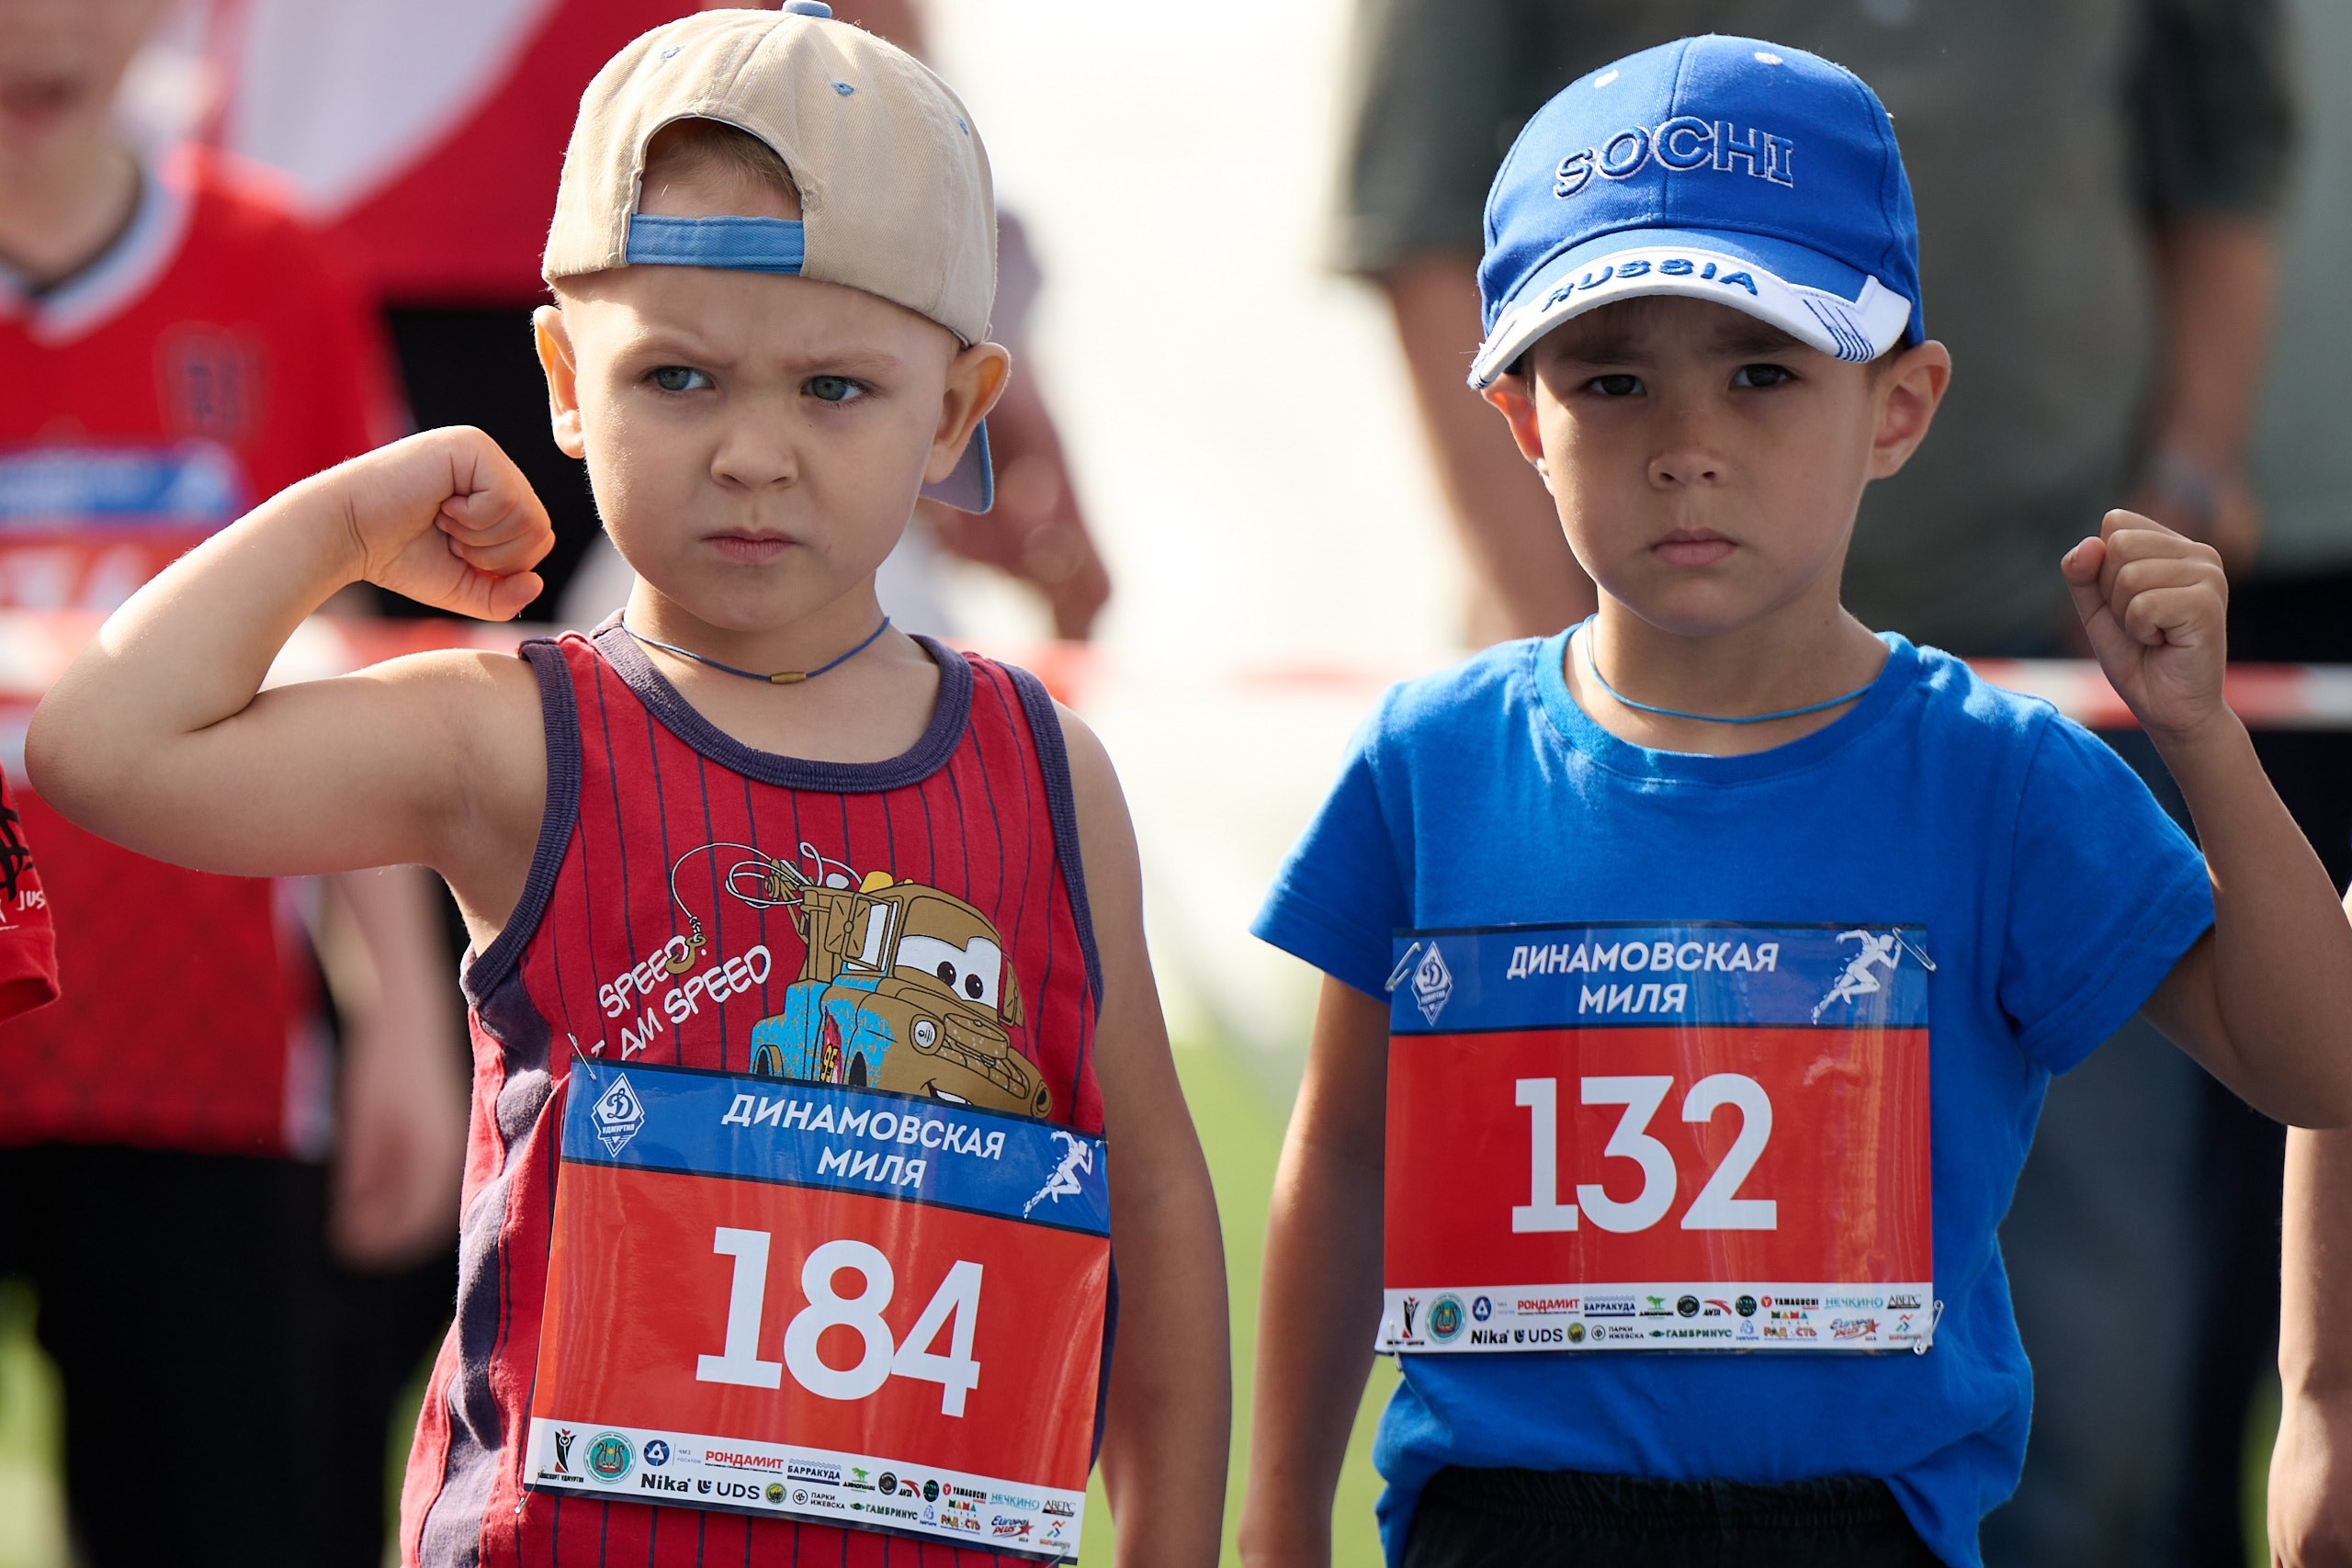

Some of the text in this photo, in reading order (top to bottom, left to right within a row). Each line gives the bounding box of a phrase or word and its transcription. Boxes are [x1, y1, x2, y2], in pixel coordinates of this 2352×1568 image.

[1553, 115, 1793, 200] SOCHI
[1542, 258, 1758, 312] RUSSIA
[1506, 942, 1780, 980] ДИНАМОВСКАЯ
[621, 944, 771, 1060] AM SPEED
[1578, 983, 1688, 1015] МИЛЯ
[721, 1094, 1006, 1160] ДИНАМОВСКАЯ
[1512, 1073, 1777, 1234] 132
[817, 1146, 927, 1189] МИЛЯ
[1518, 1299, 1580, 1312] РОНДАМИТ
[1584, 1303, 1635, 1313] БАРРАКУДА
[1775, 1297, 1819, 1305] YAMAGUCHI
[1826, 1296, 1883, 1308] НЕЧКИНО
[695, 1226, 984, 1417] 184
[1471, 1329, 1508, 1344] Nika
[1529, 1328, 1563, 1343] UDS
[1666, 1328, 1733, 1338] ГАМБРИНУС
[706, 1450, 784, 1469] РОНДАМИТ
[787, 1465, 841, 1480] БАРРАКУДА
[641, 1473, 689, 1493] Nika
[717, 1482, 761, 1500] UDS
[810, 1492, 835, 1501] ПАРКИ
[953, 1486, 987, 1500] YAMAGUCHI
[991, 1493, 1040, 1510] НЕЧКИНО
[810, 1499, 845, 1509] ИЖЕВСКА
[865, 1504, 918, 1520] ГАМБРИНУС
